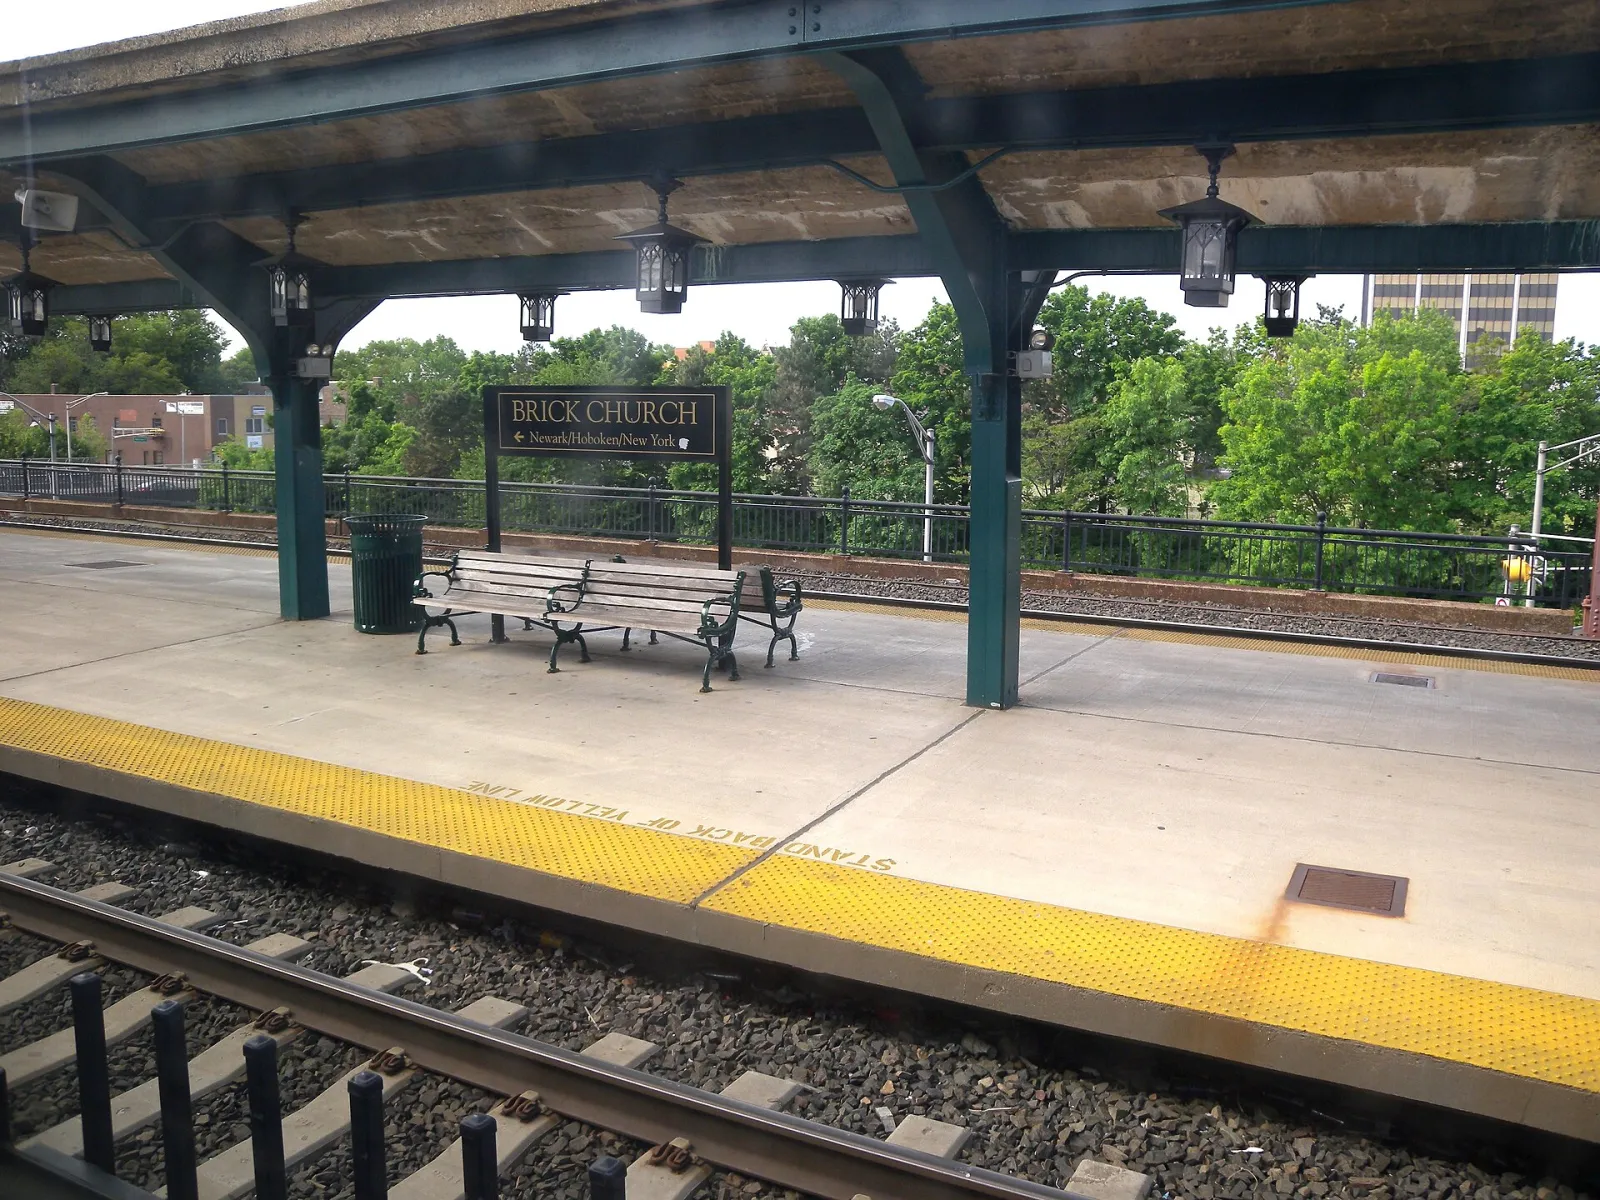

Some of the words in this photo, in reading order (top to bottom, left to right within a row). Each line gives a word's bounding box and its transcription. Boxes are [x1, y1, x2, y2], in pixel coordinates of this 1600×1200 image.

[512, 400, 580, 423] BRICK
[586, 400, 698, 424] CHURCH
[529, 431, 648, 447] Newark/Hoboken/New
[650, 434, 676, 447] York
[459, 780, 523, 799] LINE
[525, 794, 629, 821] YELLOW
[637, 817, 680, 830] OF
[688, 824, 777, 848] BACK
[785, 841, 897, 871] STAND
